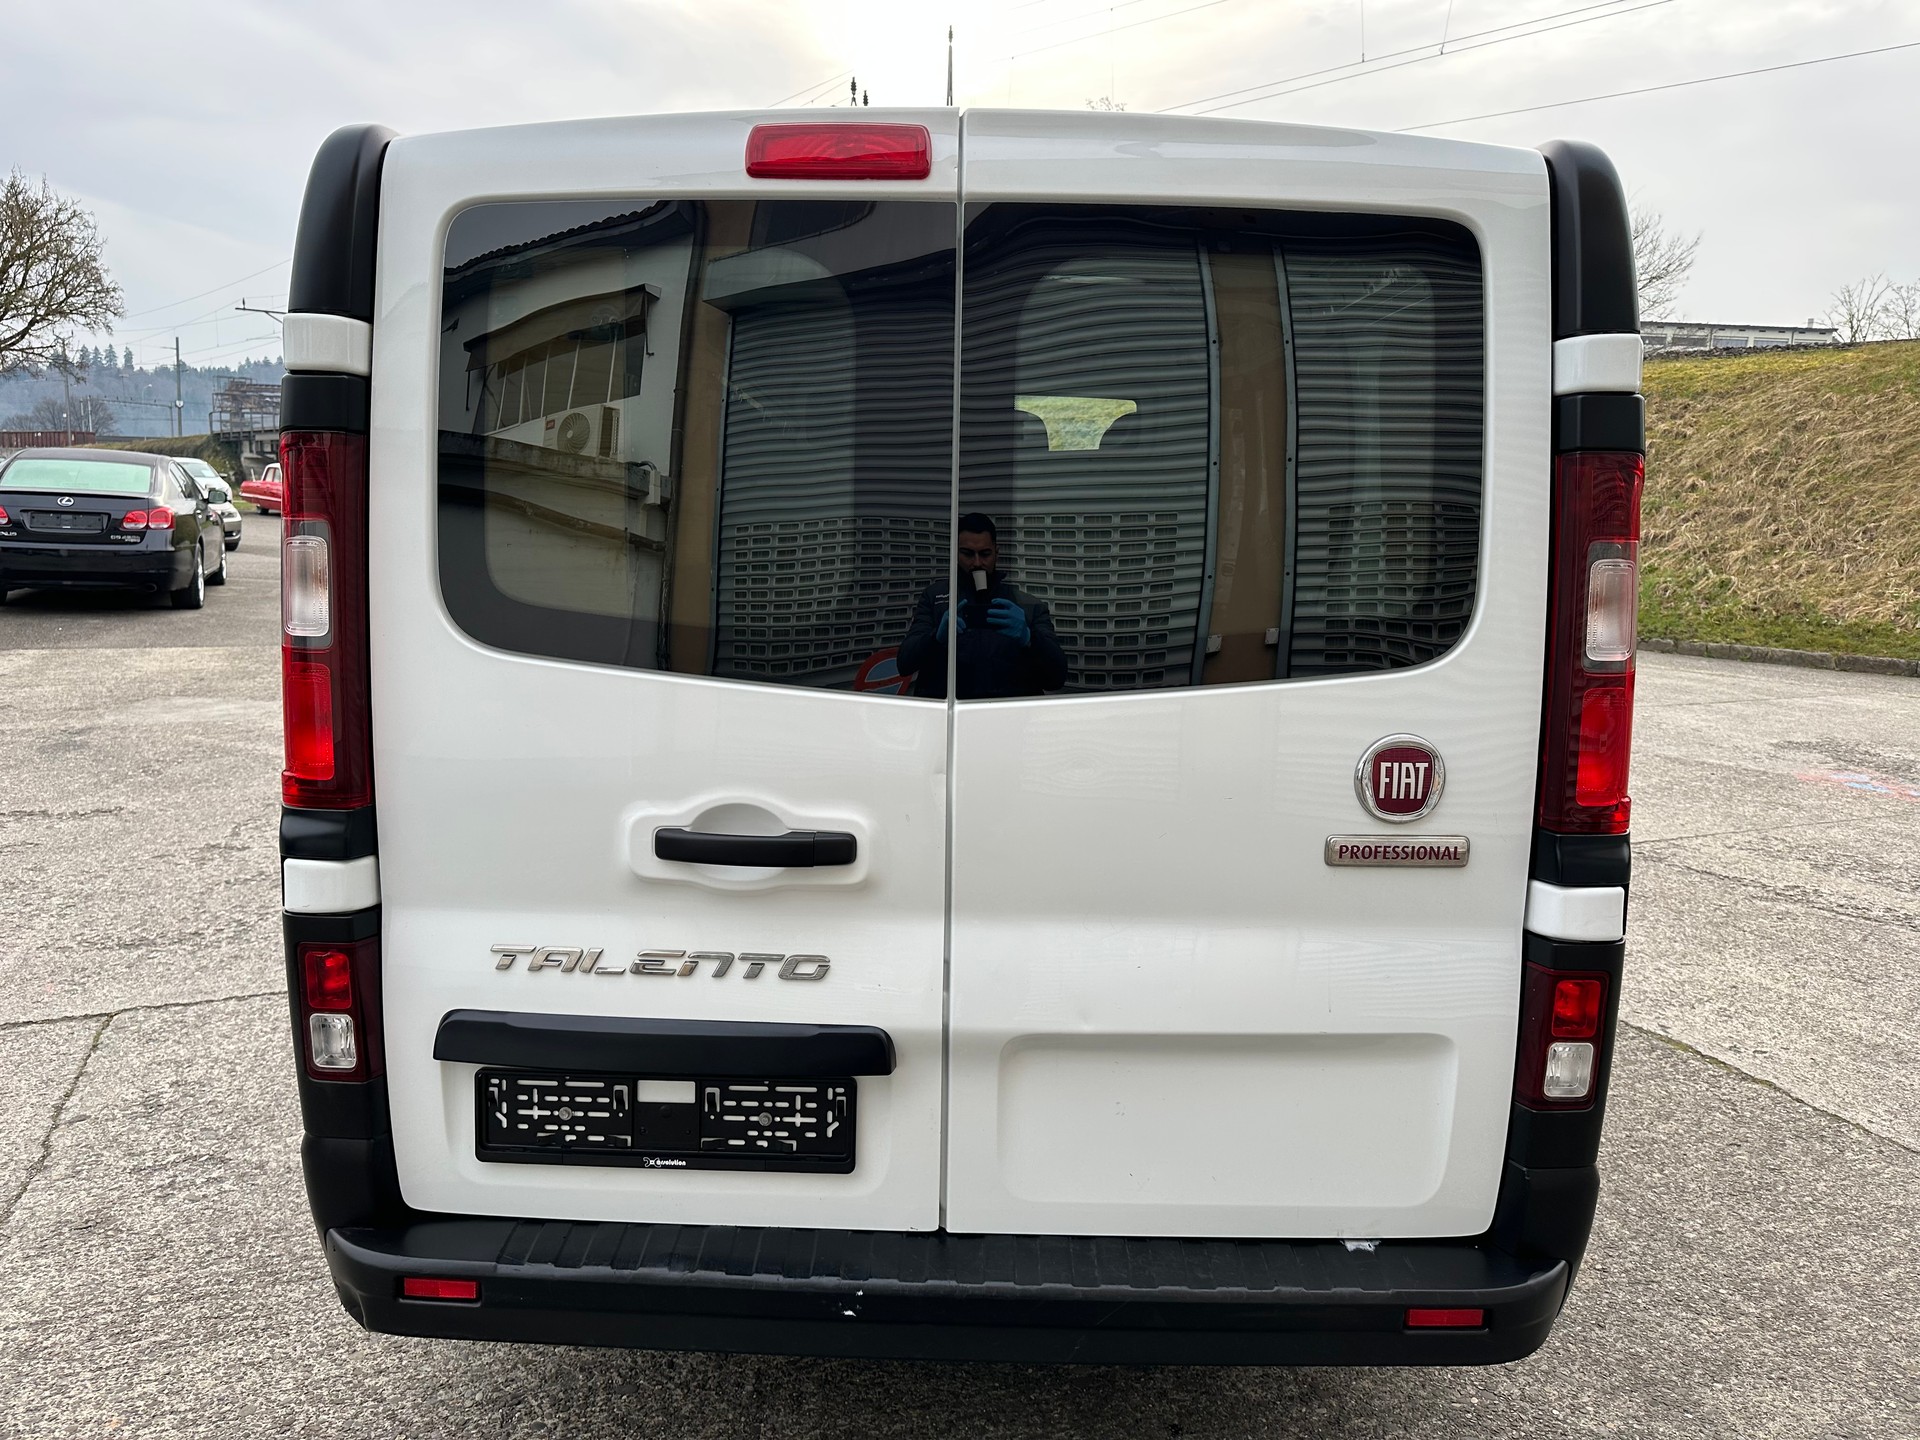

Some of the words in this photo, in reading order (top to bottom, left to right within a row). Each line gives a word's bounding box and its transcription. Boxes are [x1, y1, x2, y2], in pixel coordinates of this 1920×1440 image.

[1379, 762, 1429, 800] FIAT
[1338, 844, 1461, 861] PROFESSIONAL
[490, 943, 832, 981] TALENTO
